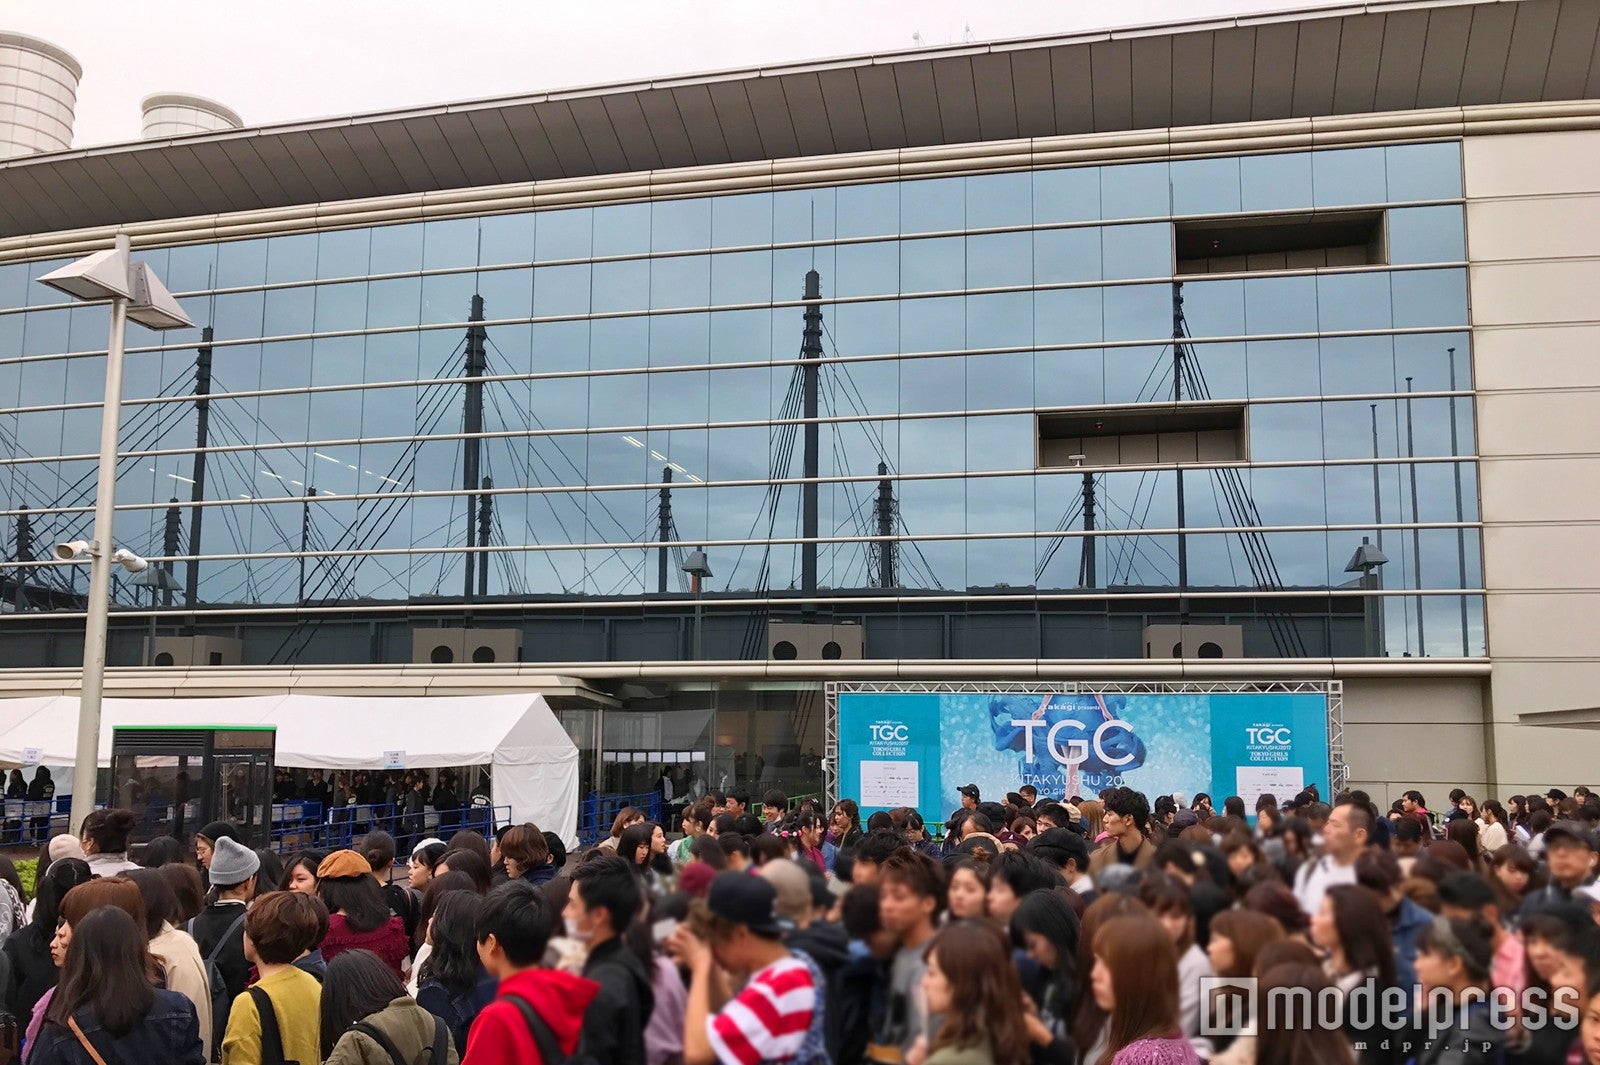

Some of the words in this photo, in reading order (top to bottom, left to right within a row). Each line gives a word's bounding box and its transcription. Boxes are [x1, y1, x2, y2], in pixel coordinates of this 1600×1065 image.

[869, 724, 909, 741] TGC
[1245, 727, 1292, 745] TGC
[1011, 719, 1135, 766] TGC
[1012, 773, 1100, 787] KITAKYUSHU
[1104, 775, 1135, 787] 2017
